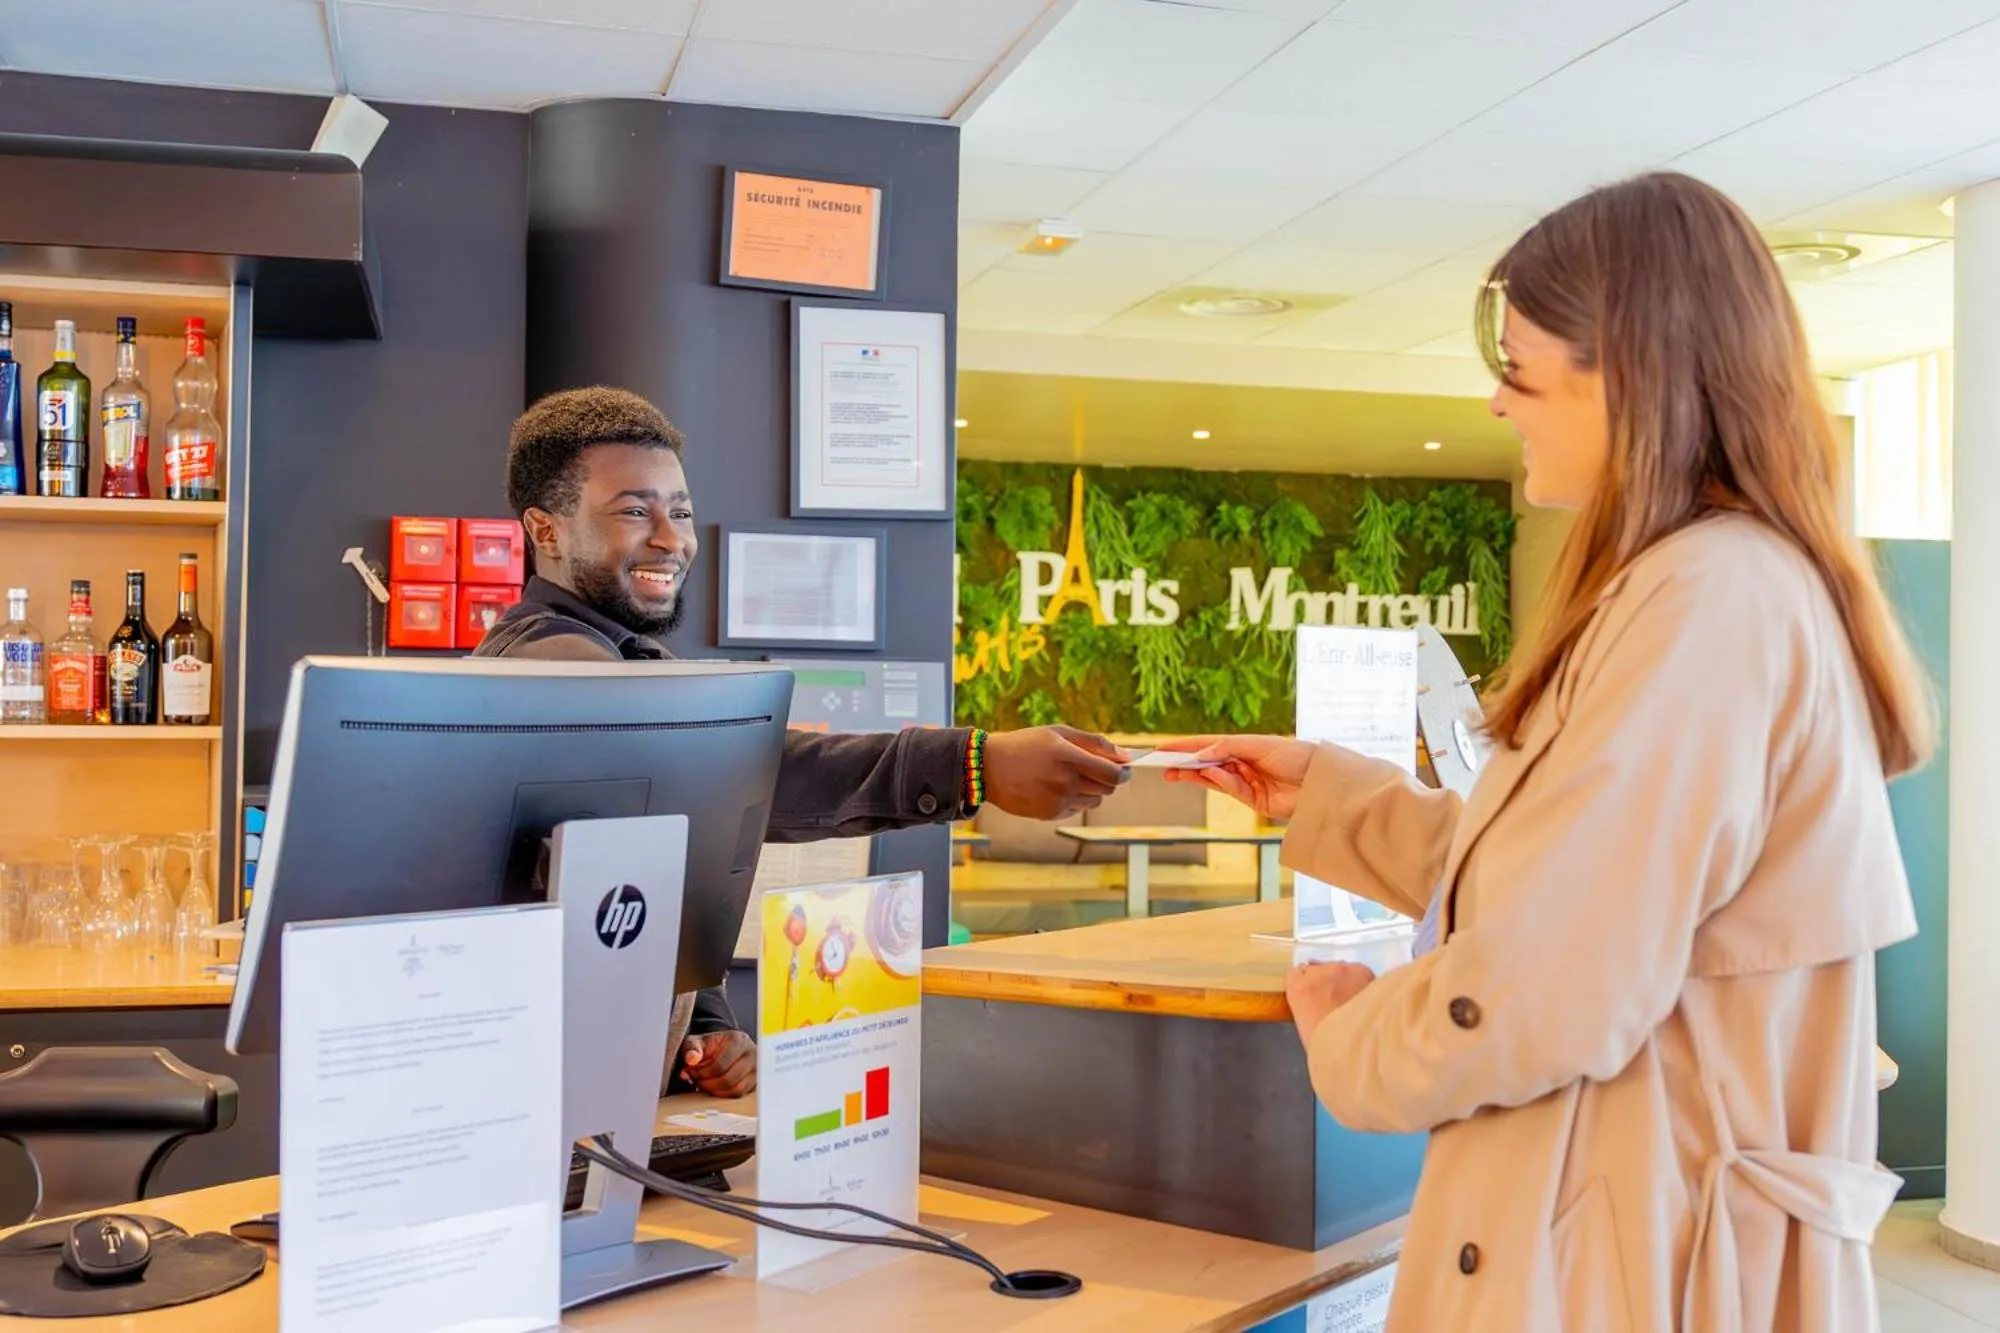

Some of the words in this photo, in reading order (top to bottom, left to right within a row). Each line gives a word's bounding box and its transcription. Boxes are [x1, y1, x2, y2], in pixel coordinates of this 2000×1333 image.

[807, 198, 863, 214] INCENDIE
[43, 402, 67, 428] 51
[1226, 566, 1480, 635] Montreuil
[600, 884, 644, 949] hp
